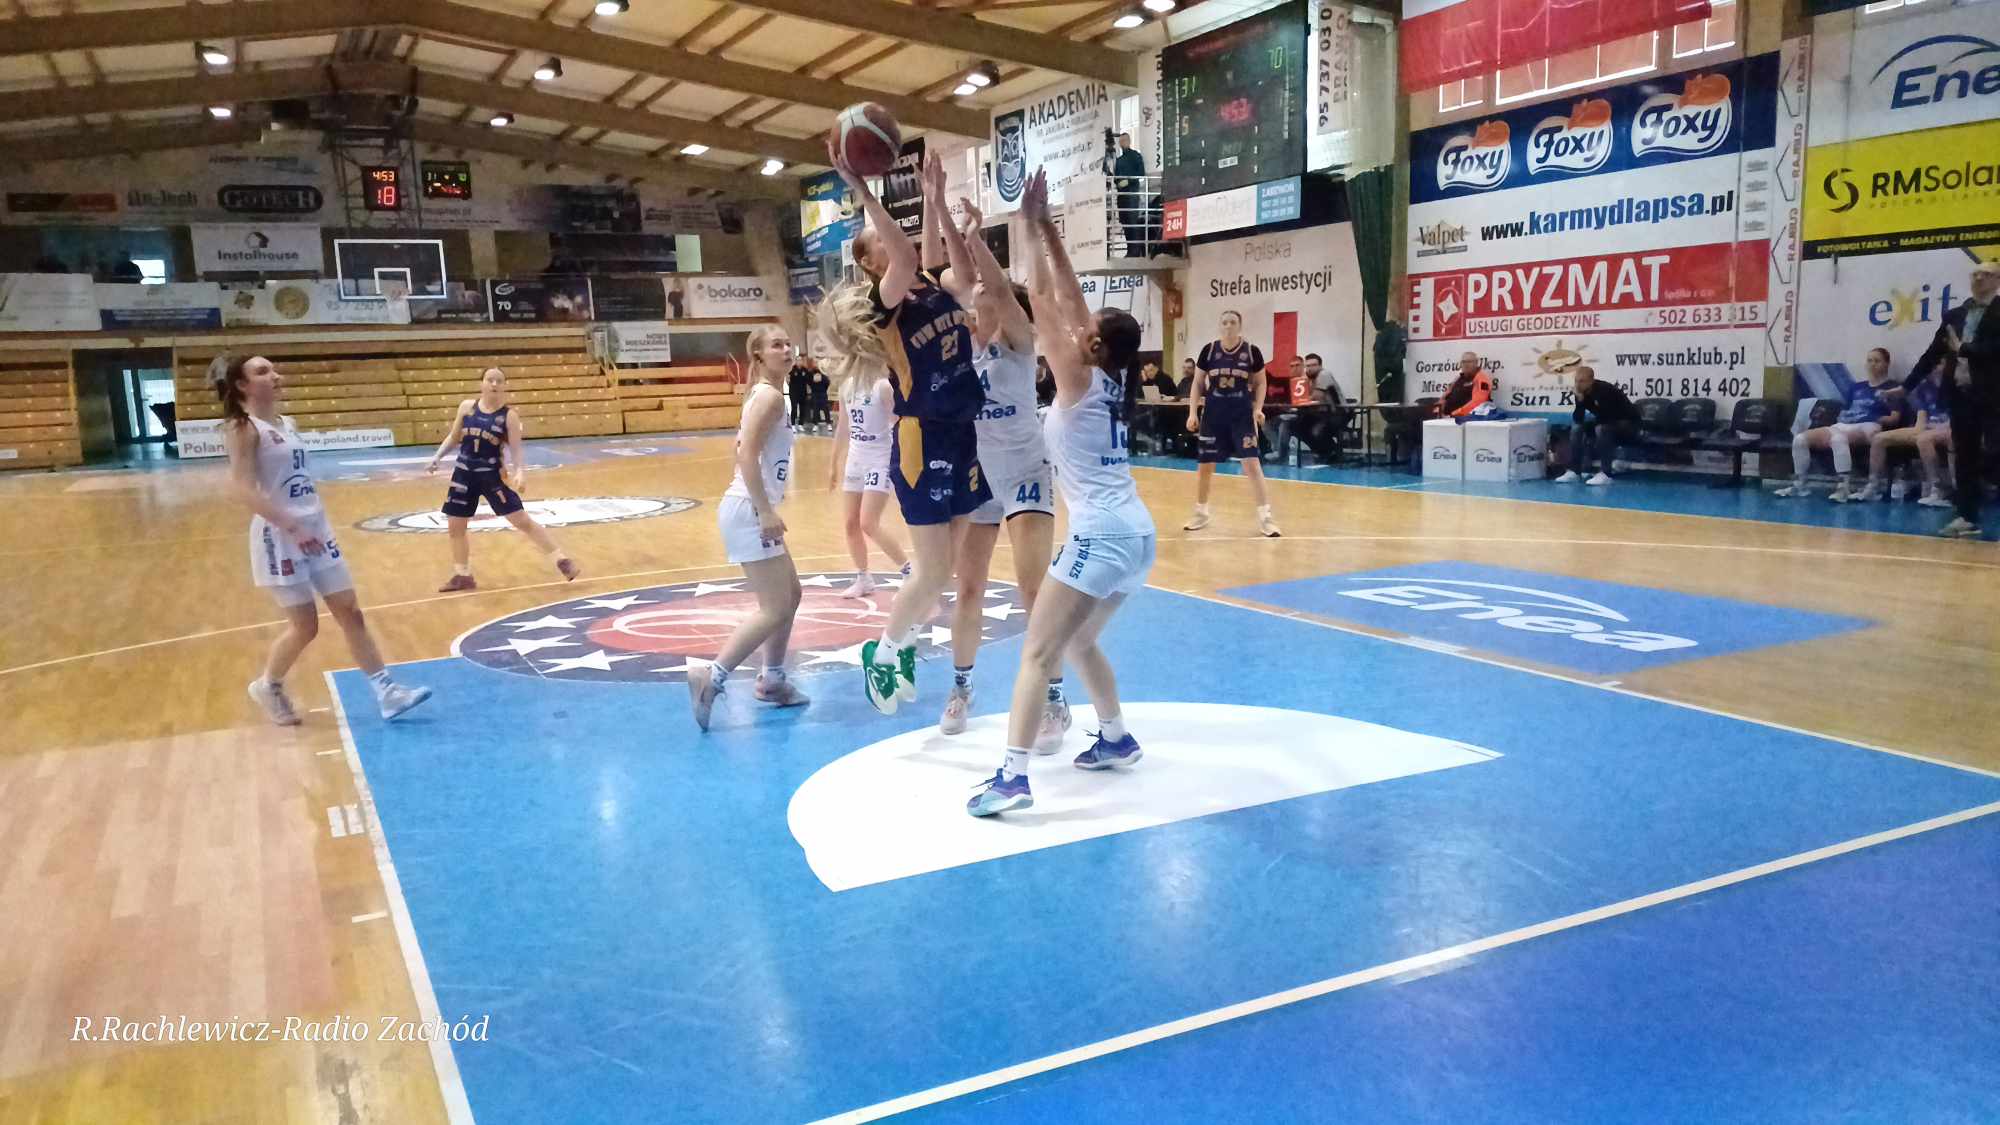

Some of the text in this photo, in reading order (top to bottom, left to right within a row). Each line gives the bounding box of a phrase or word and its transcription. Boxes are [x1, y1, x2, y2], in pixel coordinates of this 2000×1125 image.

[1320, 59, 1330, 96] 737
[1029, 82, 1109, 129] AKADEMIA
[1639, 104, 1722, 145] Foxy
[1534, 125, 1606, 165] Foxy
[1442, 148, 1505, 180] Foxy
[1481, 190, 1734, 241] www.karmydlapsa.pl
[1419, 224, 1465, 251] Valpet
[1244, 242, 1292, 263] Polska
[708, 285, 763, 298] bokaro
[1109, 274, 1144, 290] Enea
[1210, 265, 1332, 298] Strefa Inwestycji
[1467, 254, 1670, 314] PRYZMAT
[1468, 314, 1600, 334] USŁUGI GEODEZYJNE
[1659, 308, 1687, 325] 502
[1693, 307, 1722, 324] 633
[1416, 360, 1461, 374] Gorzów
[1615, 345, 1746, 369] www.sunklub.pl
[1293, 380, 1305, 396] 5
[1615, 376, 1751, 398] tel. 501 814 402
[1510, 393, 1550, 407] Sun
[1016, 482, 1041, 503] 44
[1336, 584, 1698, 652] Enea
